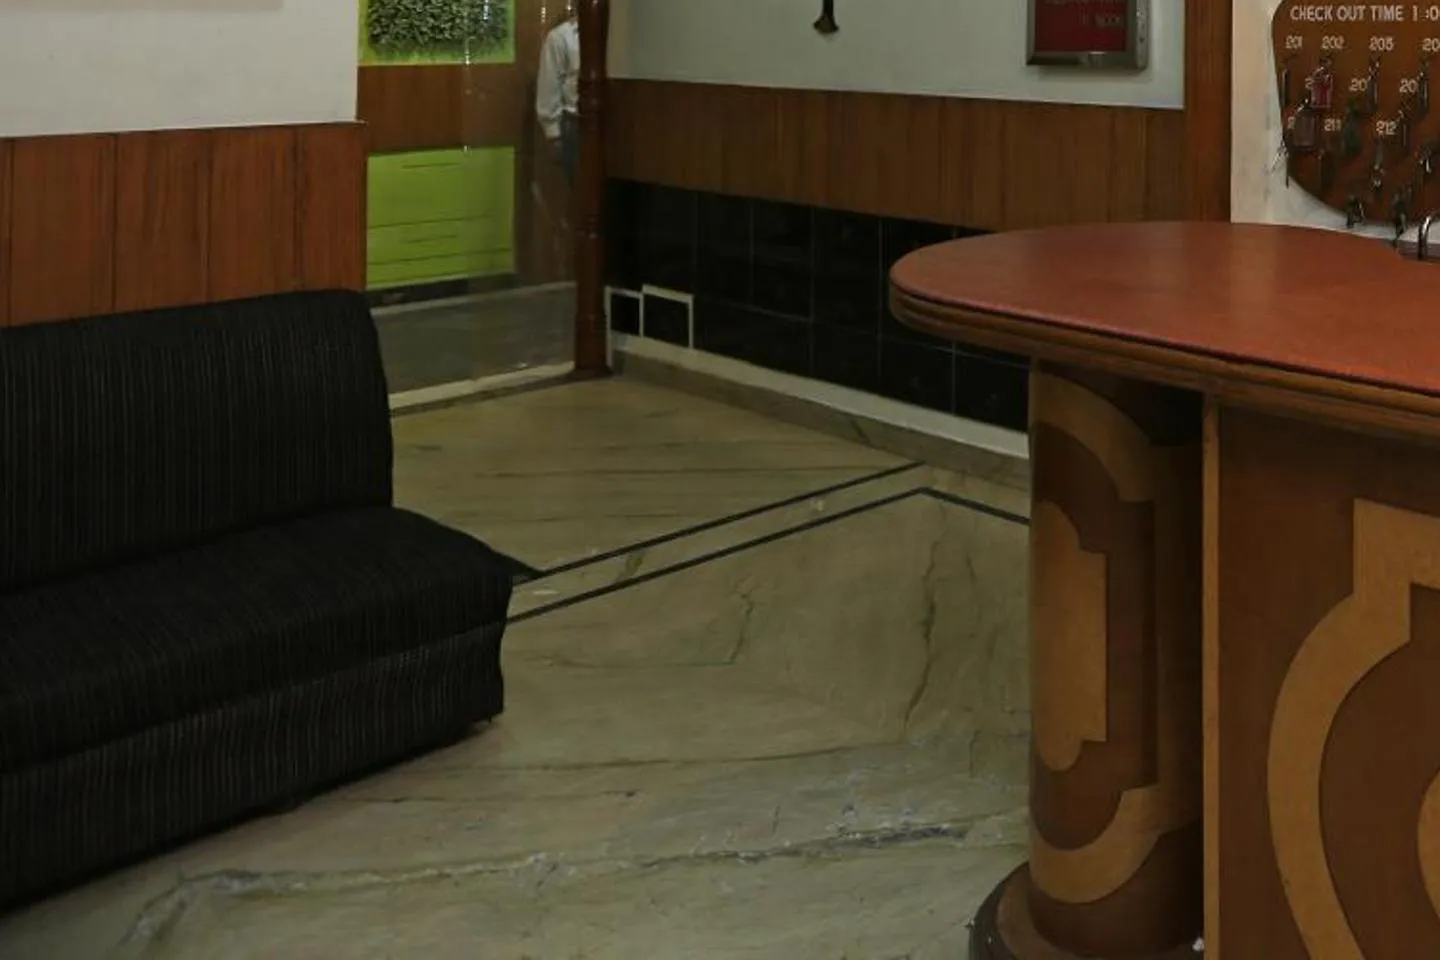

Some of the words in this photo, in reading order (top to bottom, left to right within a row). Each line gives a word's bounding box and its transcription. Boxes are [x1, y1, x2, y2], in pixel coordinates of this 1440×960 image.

[1290, 5, 1333, 21] CHECK
[1336, 5, 1366, 21] OUT
[1369, 4, 1404, 21] TIME
[1349, 78, 1367, 92] 20
[1399, 78, 1417, 93] 20
